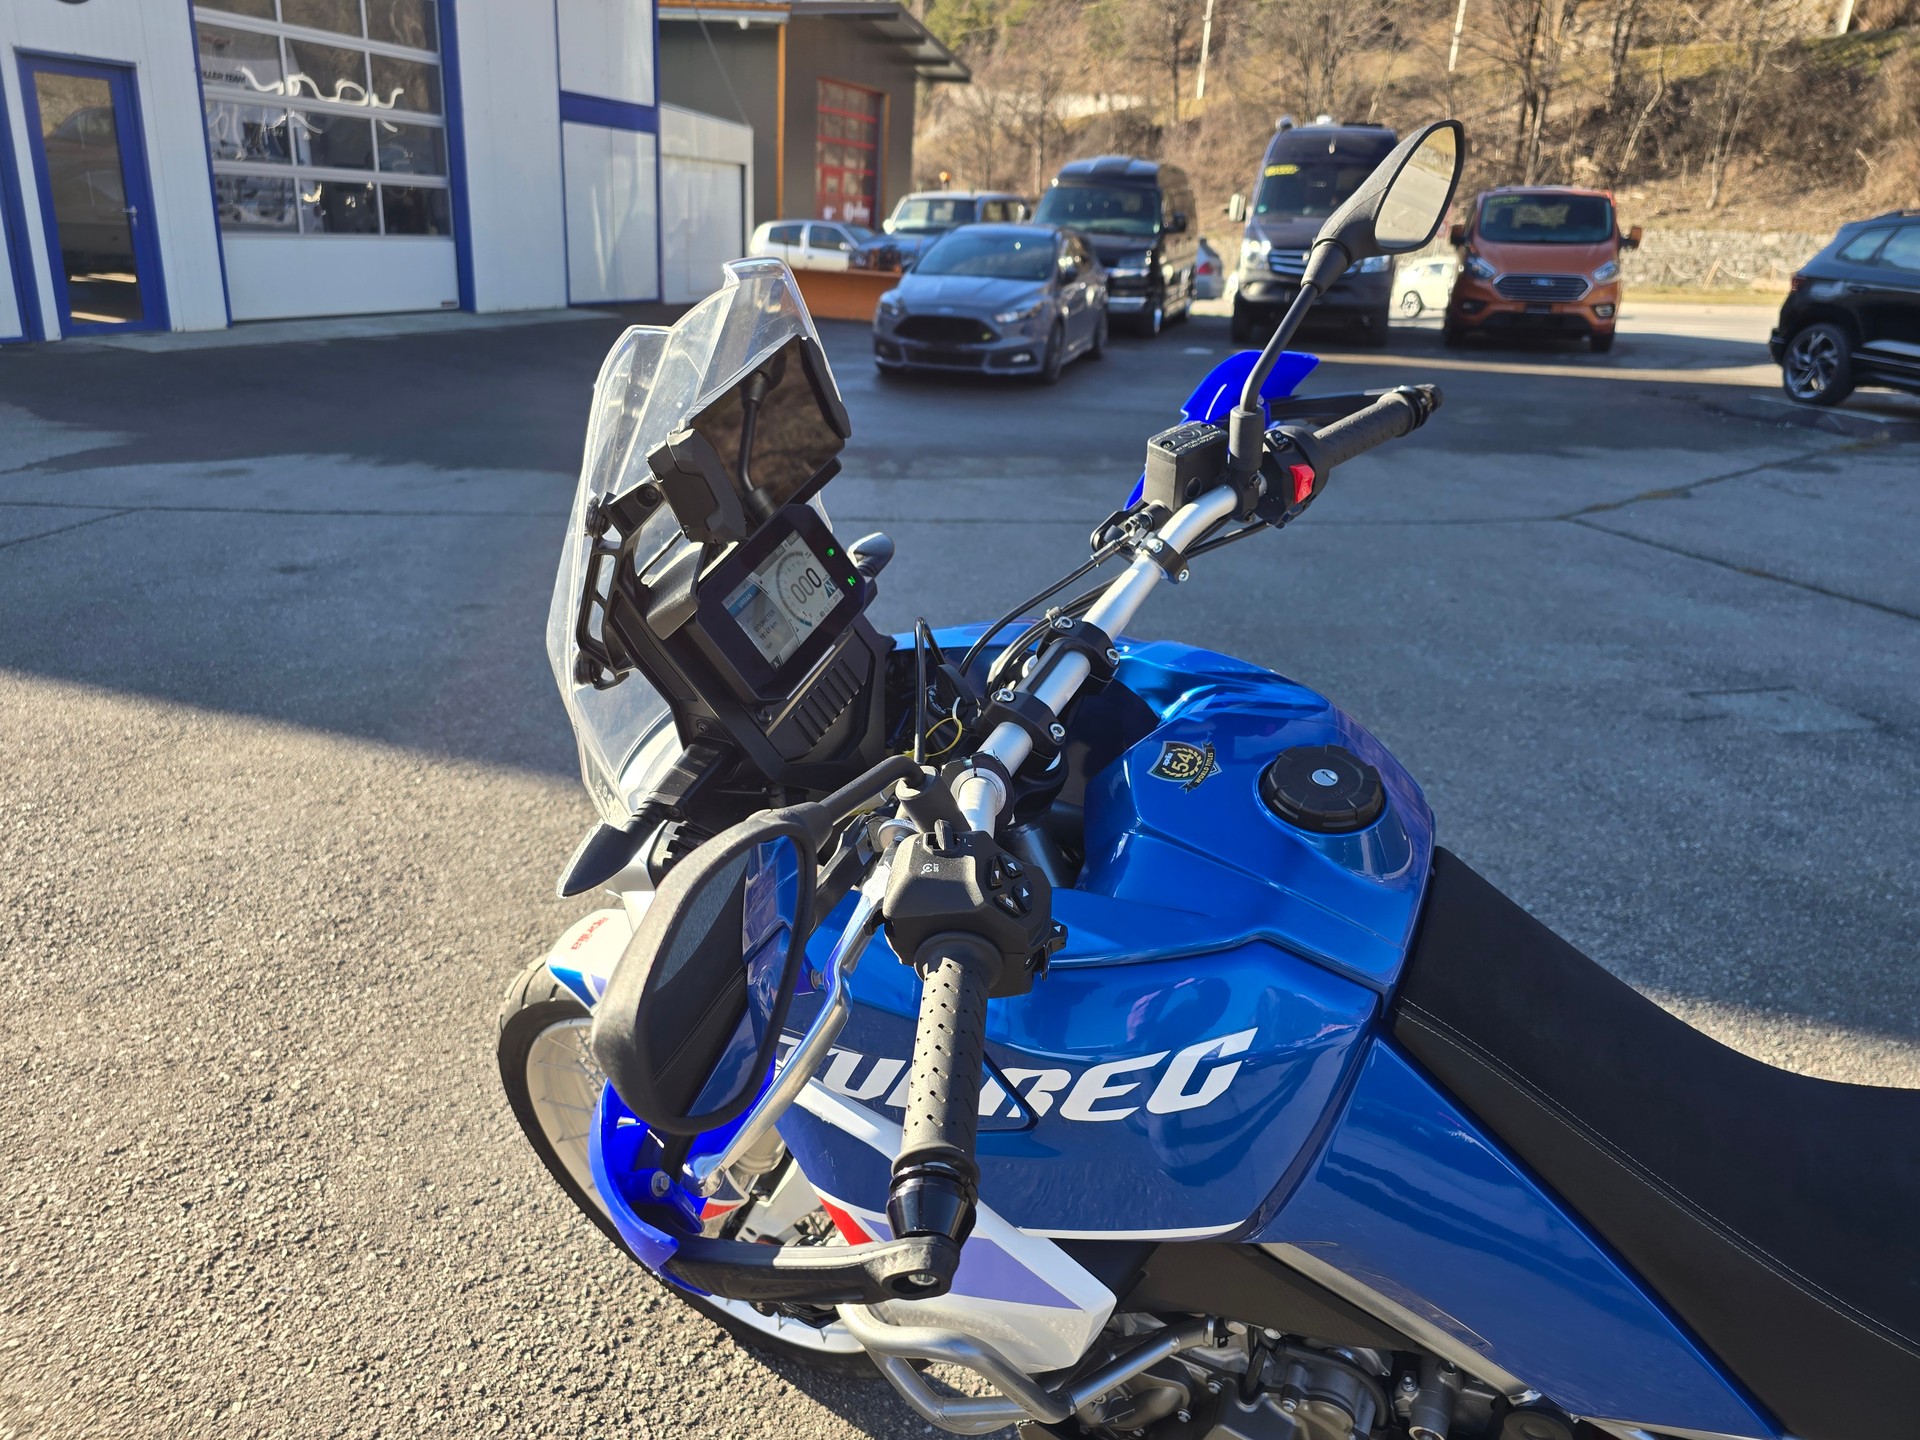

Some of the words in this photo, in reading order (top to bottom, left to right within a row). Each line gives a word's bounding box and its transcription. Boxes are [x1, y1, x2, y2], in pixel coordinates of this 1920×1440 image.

[225, 72, 246, 84] TEAM
[847, 576, 857, 586] N
[738, 593, 753, 608] URBAN
[754, 610, 776, 632] ODOMETER
[1171, 752, 1195, 773] 54
[1195, 767, 1209, 783] WORLD
